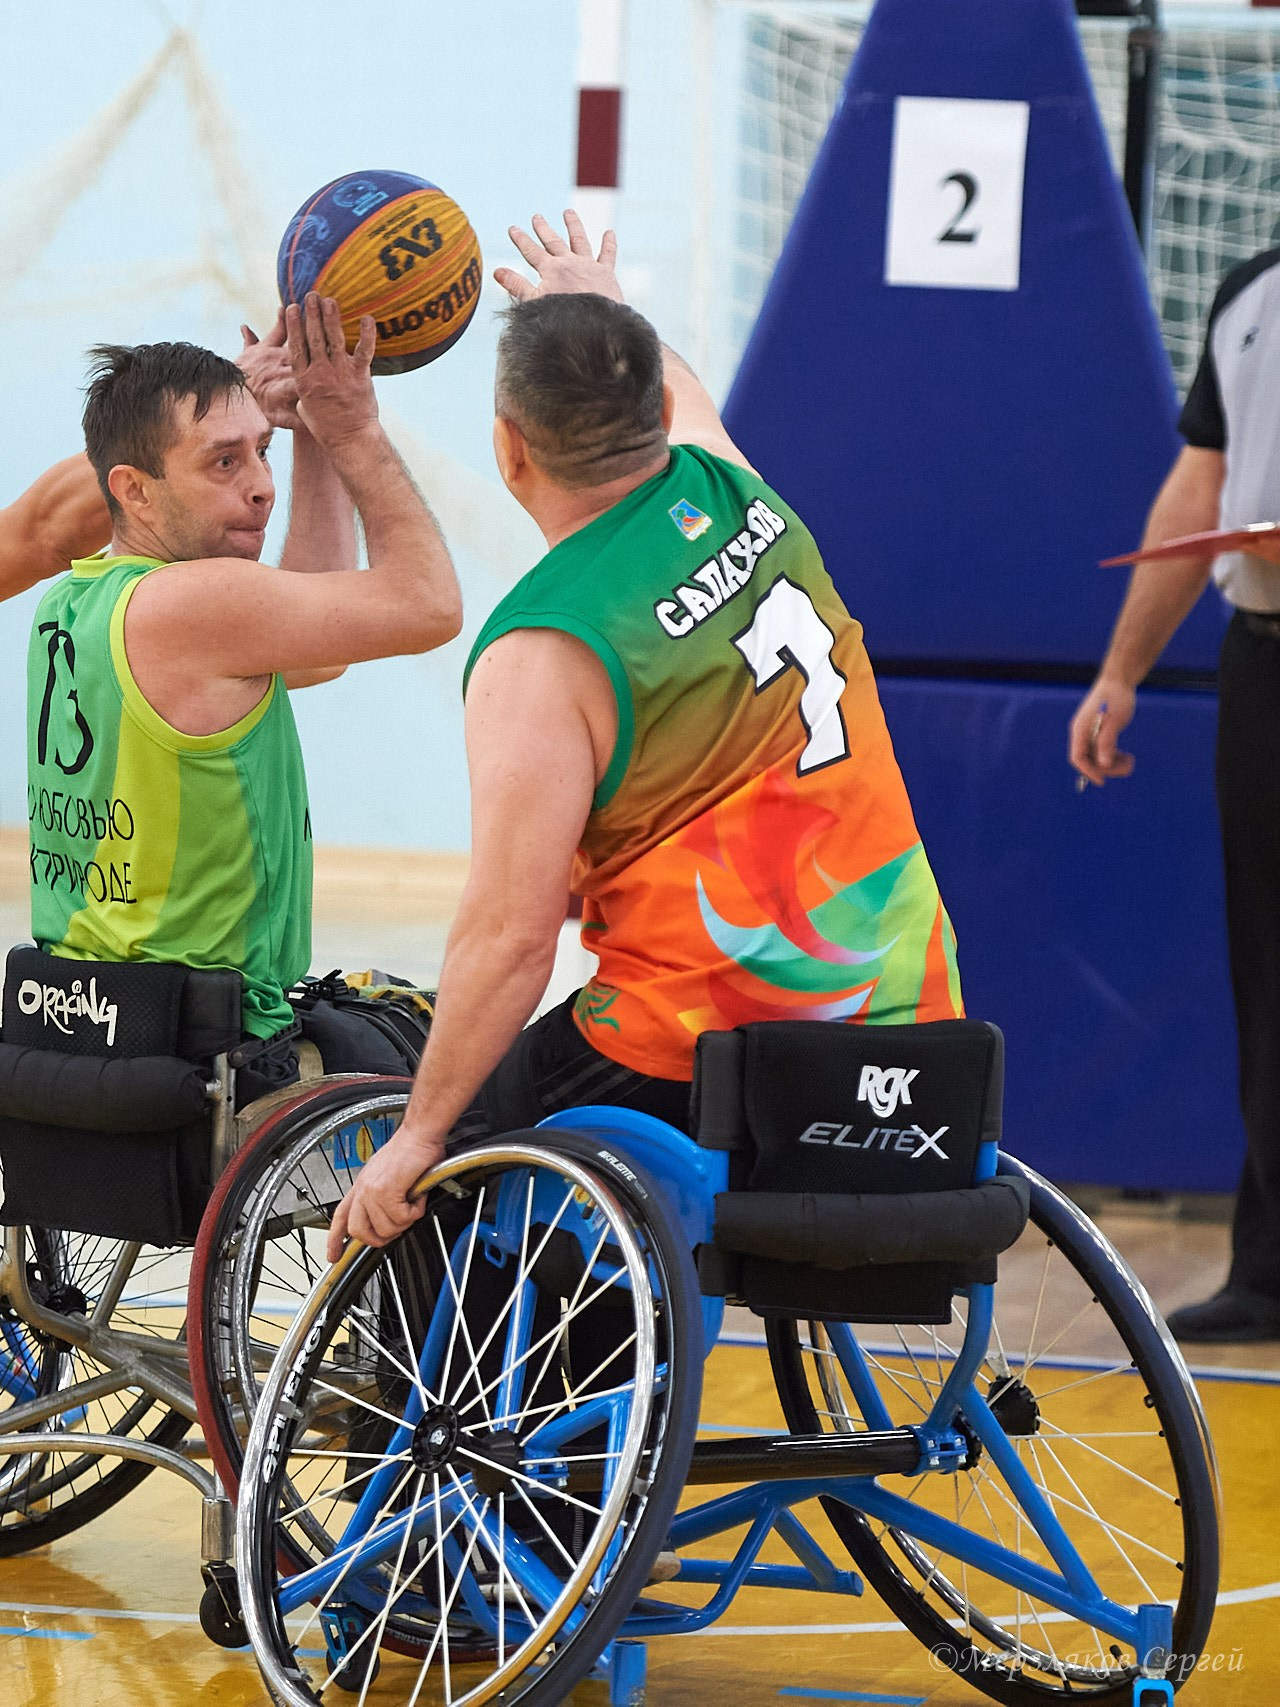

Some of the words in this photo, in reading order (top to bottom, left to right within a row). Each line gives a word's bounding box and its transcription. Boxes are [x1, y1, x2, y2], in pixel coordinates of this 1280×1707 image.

[936, 172, 981, 243] 2
[375, 256, 481, 340] Wilson
[653, 496, 787, 640] САЛАХОВ
[729, 571, 852, 778] 7
[799, 1121, 951, 1160] ELITEX
